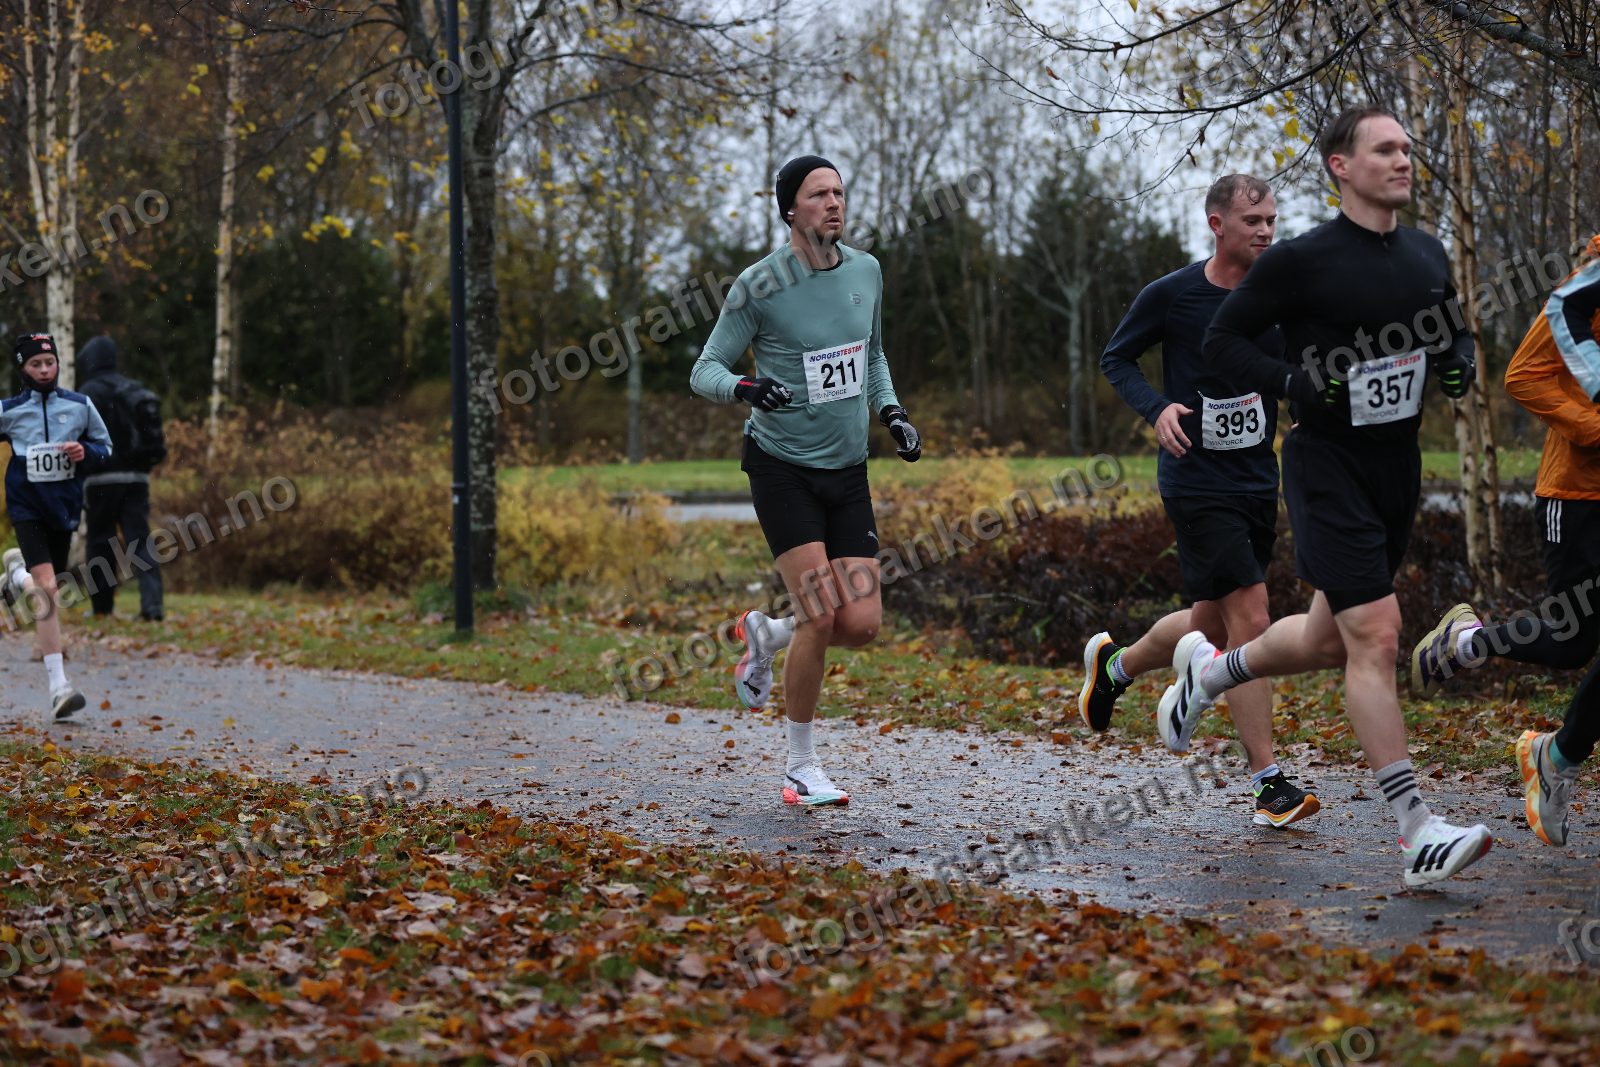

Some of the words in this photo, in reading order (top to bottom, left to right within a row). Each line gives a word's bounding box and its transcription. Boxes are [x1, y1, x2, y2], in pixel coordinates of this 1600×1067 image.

[820, 357, 856, 389] 211
[1367, 369, 1415, 408] 357
[1215, 407, 1259, 438] 393
[32, 452, 71, 472] 1013
